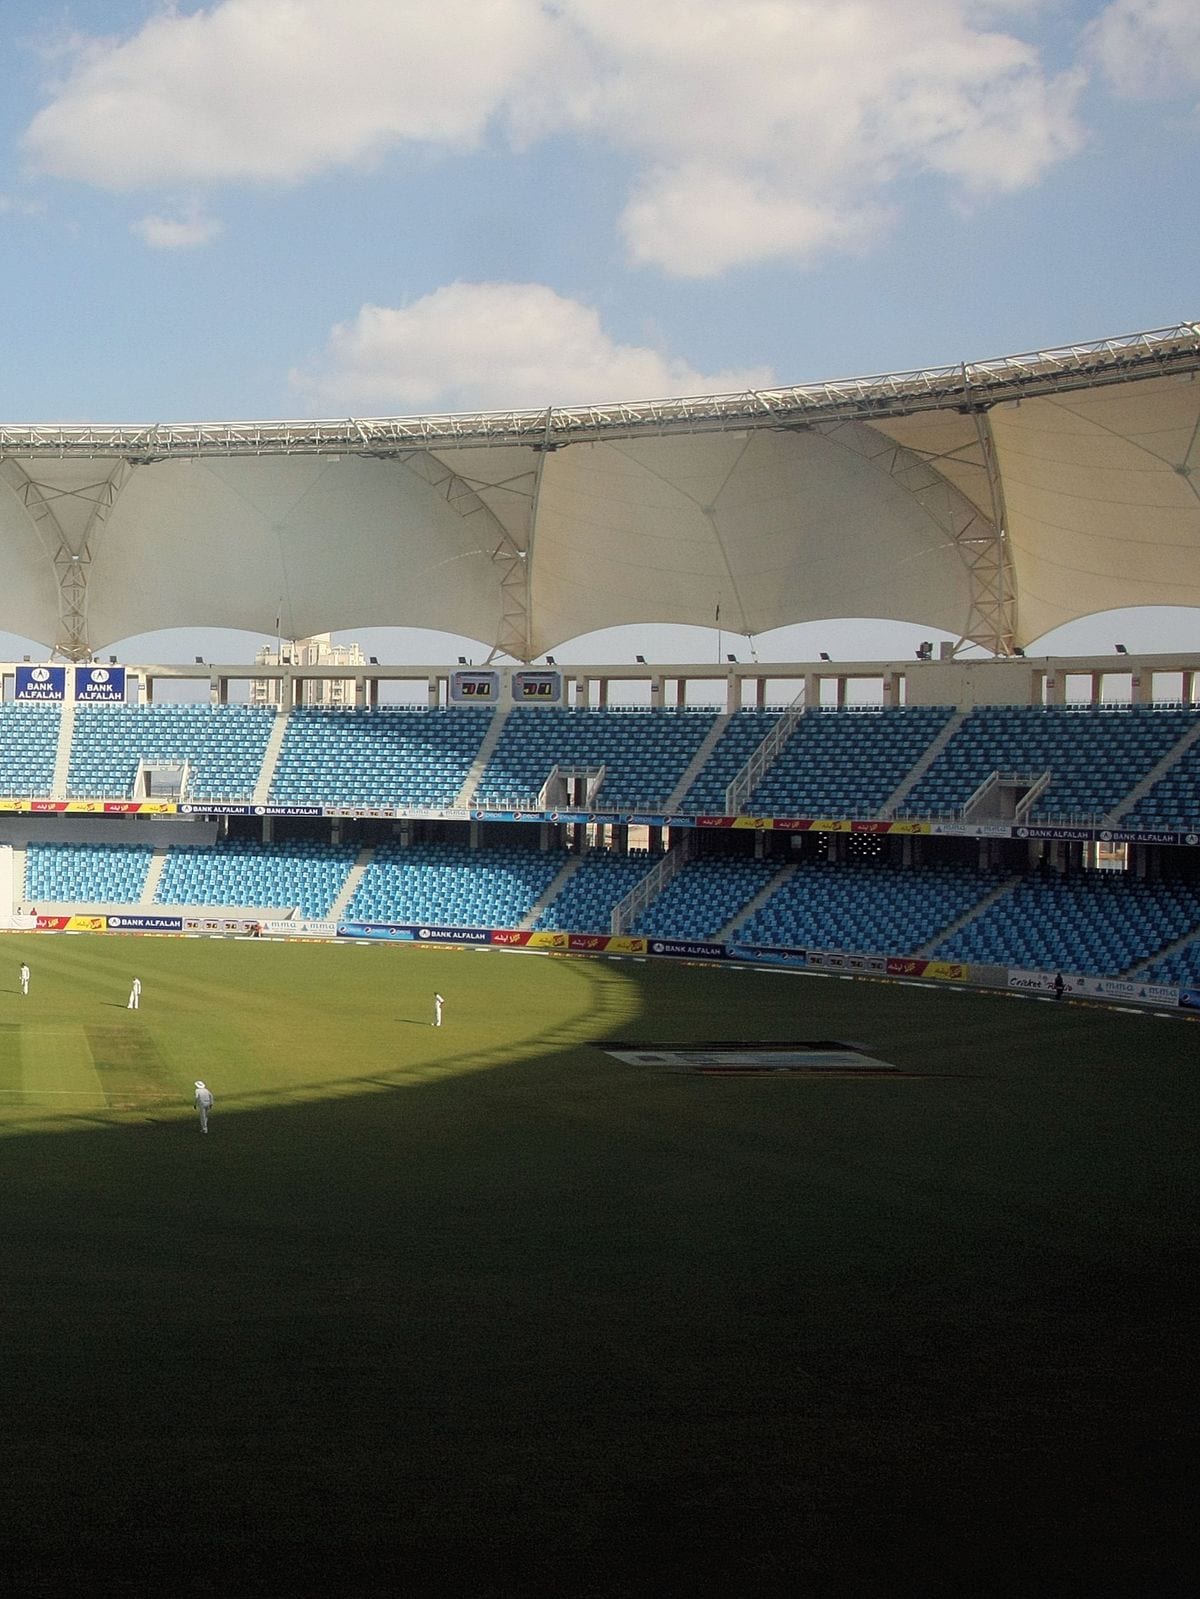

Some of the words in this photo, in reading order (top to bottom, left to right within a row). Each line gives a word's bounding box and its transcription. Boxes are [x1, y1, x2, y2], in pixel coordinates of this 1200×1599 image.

[87, 684, 113, 692] BANK
[1030, 830, 1050, 838] BANK
[1052, 830, 1088, 839] ALFALAH
[1113, 833, 1136, 841] BANK
[1137, 834, 1174, 842] ALFALAH
[665, 945, 685, 953] BANK
[687, 946, 720, 954] ALFALAH
[1010, 978, 1042, 988] Cricket
